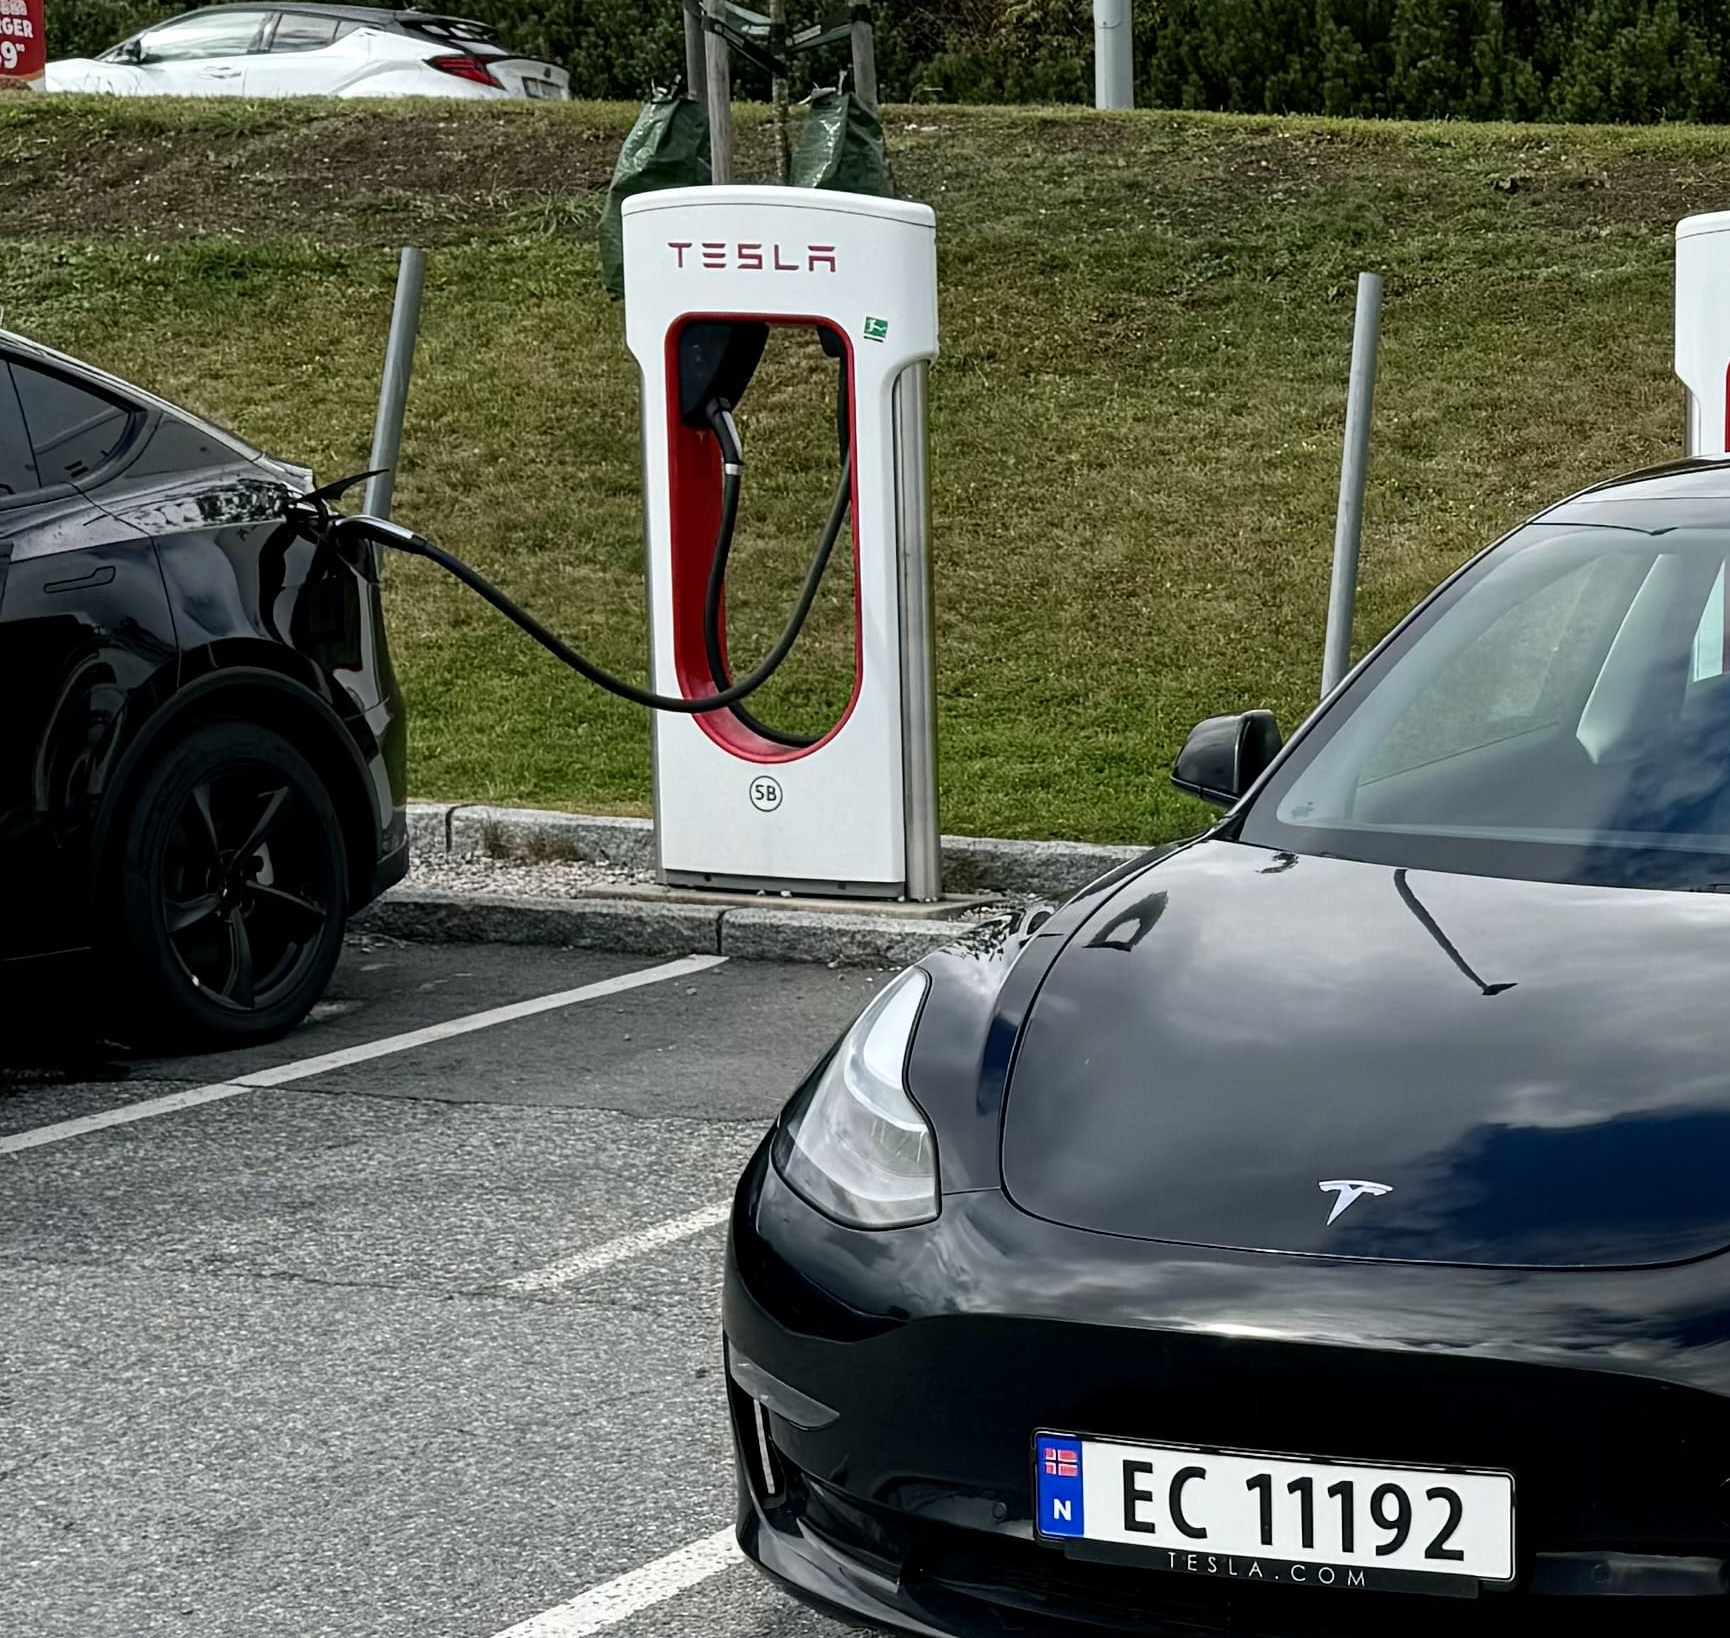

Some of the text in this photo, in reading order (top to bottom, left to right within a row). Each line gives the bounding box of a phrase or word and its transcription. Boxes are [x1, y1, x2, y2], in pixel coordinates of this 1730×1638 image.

[0, 16, 34, 38] GER
[667, 242, 836, 273] TESLA
[755, 784, 777, 801] 5B
[1053, 1498, 1072, 1521] N
[1122, 1459, 1465, 1562] EC 11192
[1167, 1551, 1366, 1587] TESLA.COM
